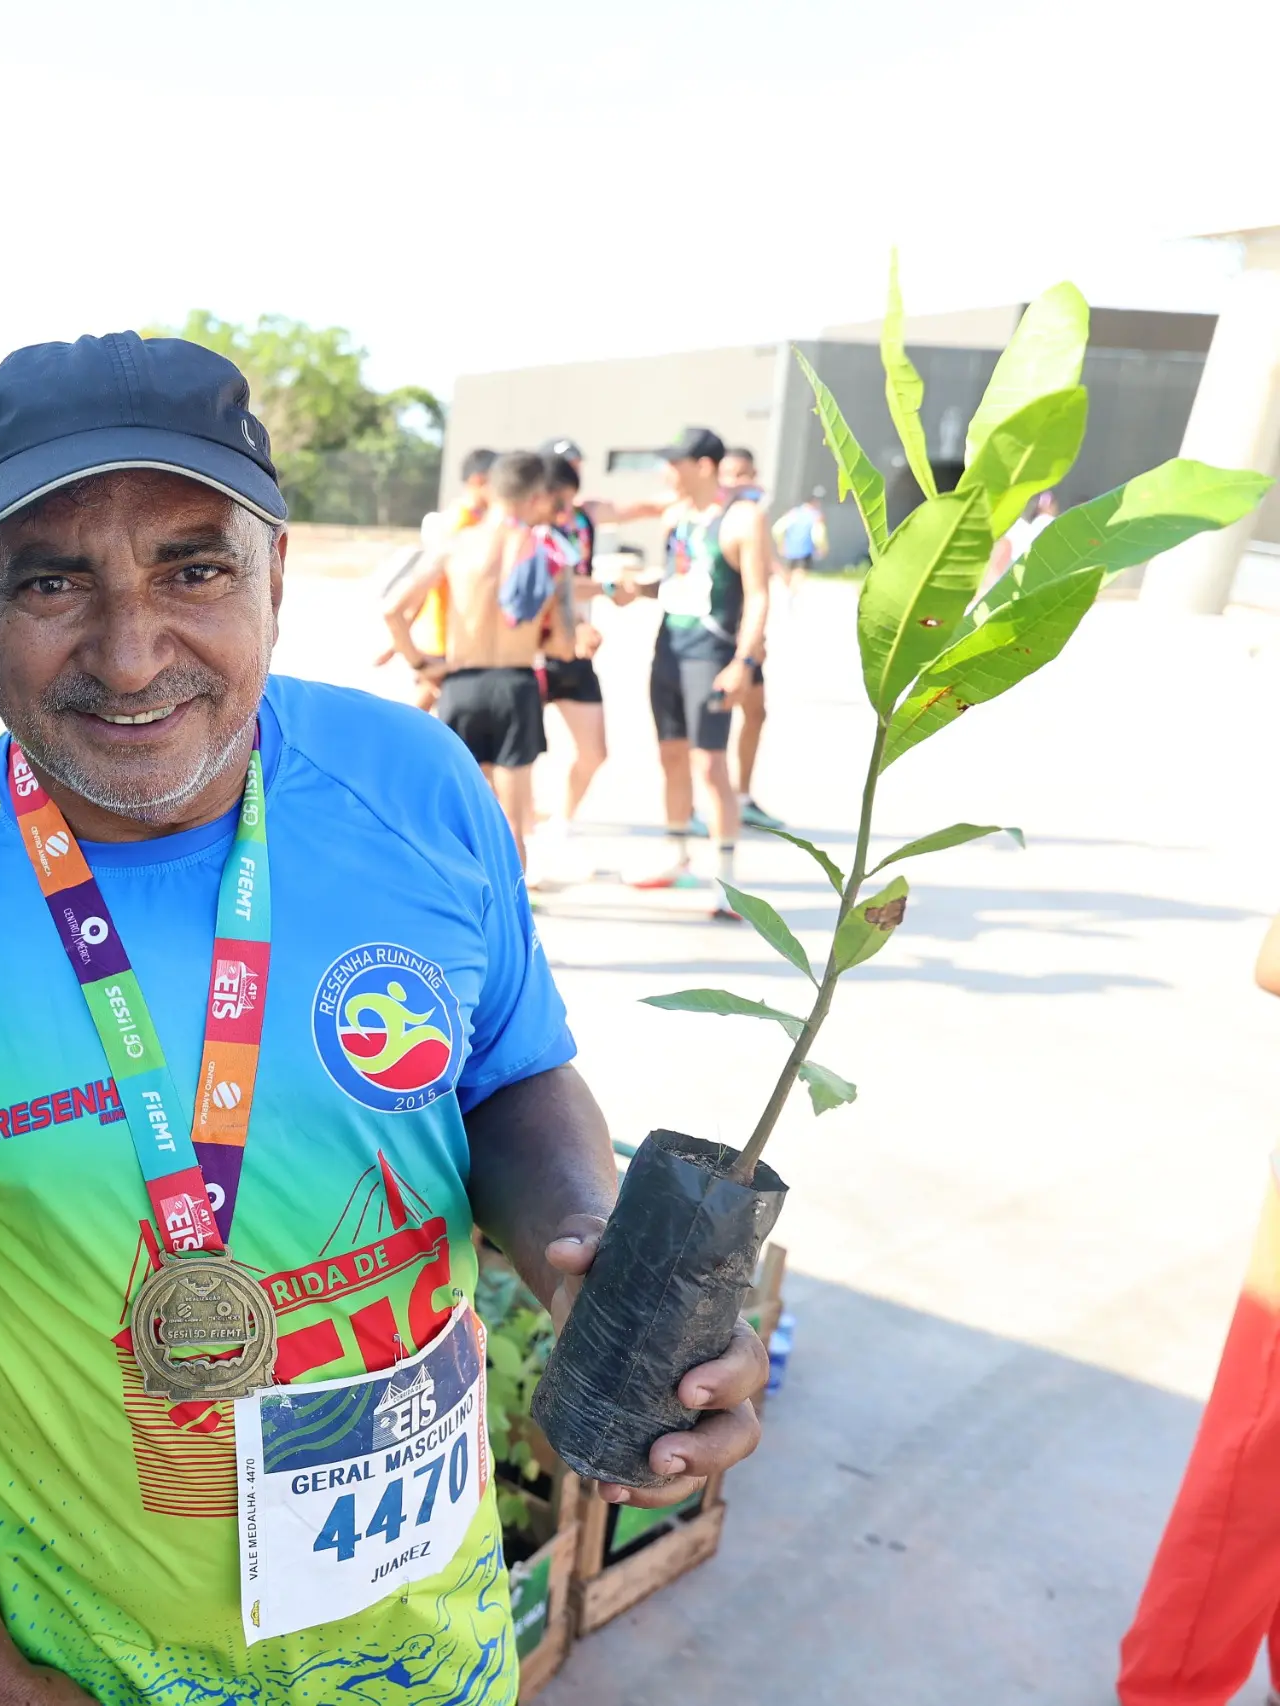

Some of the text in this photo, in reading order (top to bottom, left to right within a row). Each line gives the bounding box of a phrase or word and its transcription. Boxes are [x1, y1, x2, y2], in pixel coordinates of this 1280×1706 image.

[31, 826, 43, 849] CENTRO
[63, 907, 80, 934] CENTRO
[319, 948, 443, 1016] RESENHA RUNNING
[204, 1061, 215, 1092] CENTRO
[394, 1088, 437, 1111] 2015
[270, 1245, 389, 1306] RIDA DE
[291, 1393, 474, 1495] GERAL MASCULINO
[246, 1458, 255, 1483] 4470
[313, 1432, 468, 1562] 4470
[247, 1492, 258, 1549] MEDALHA
[249, 1551, 260, 1581] VALE
[371, 1540, 431, 1583] JUAREZ
